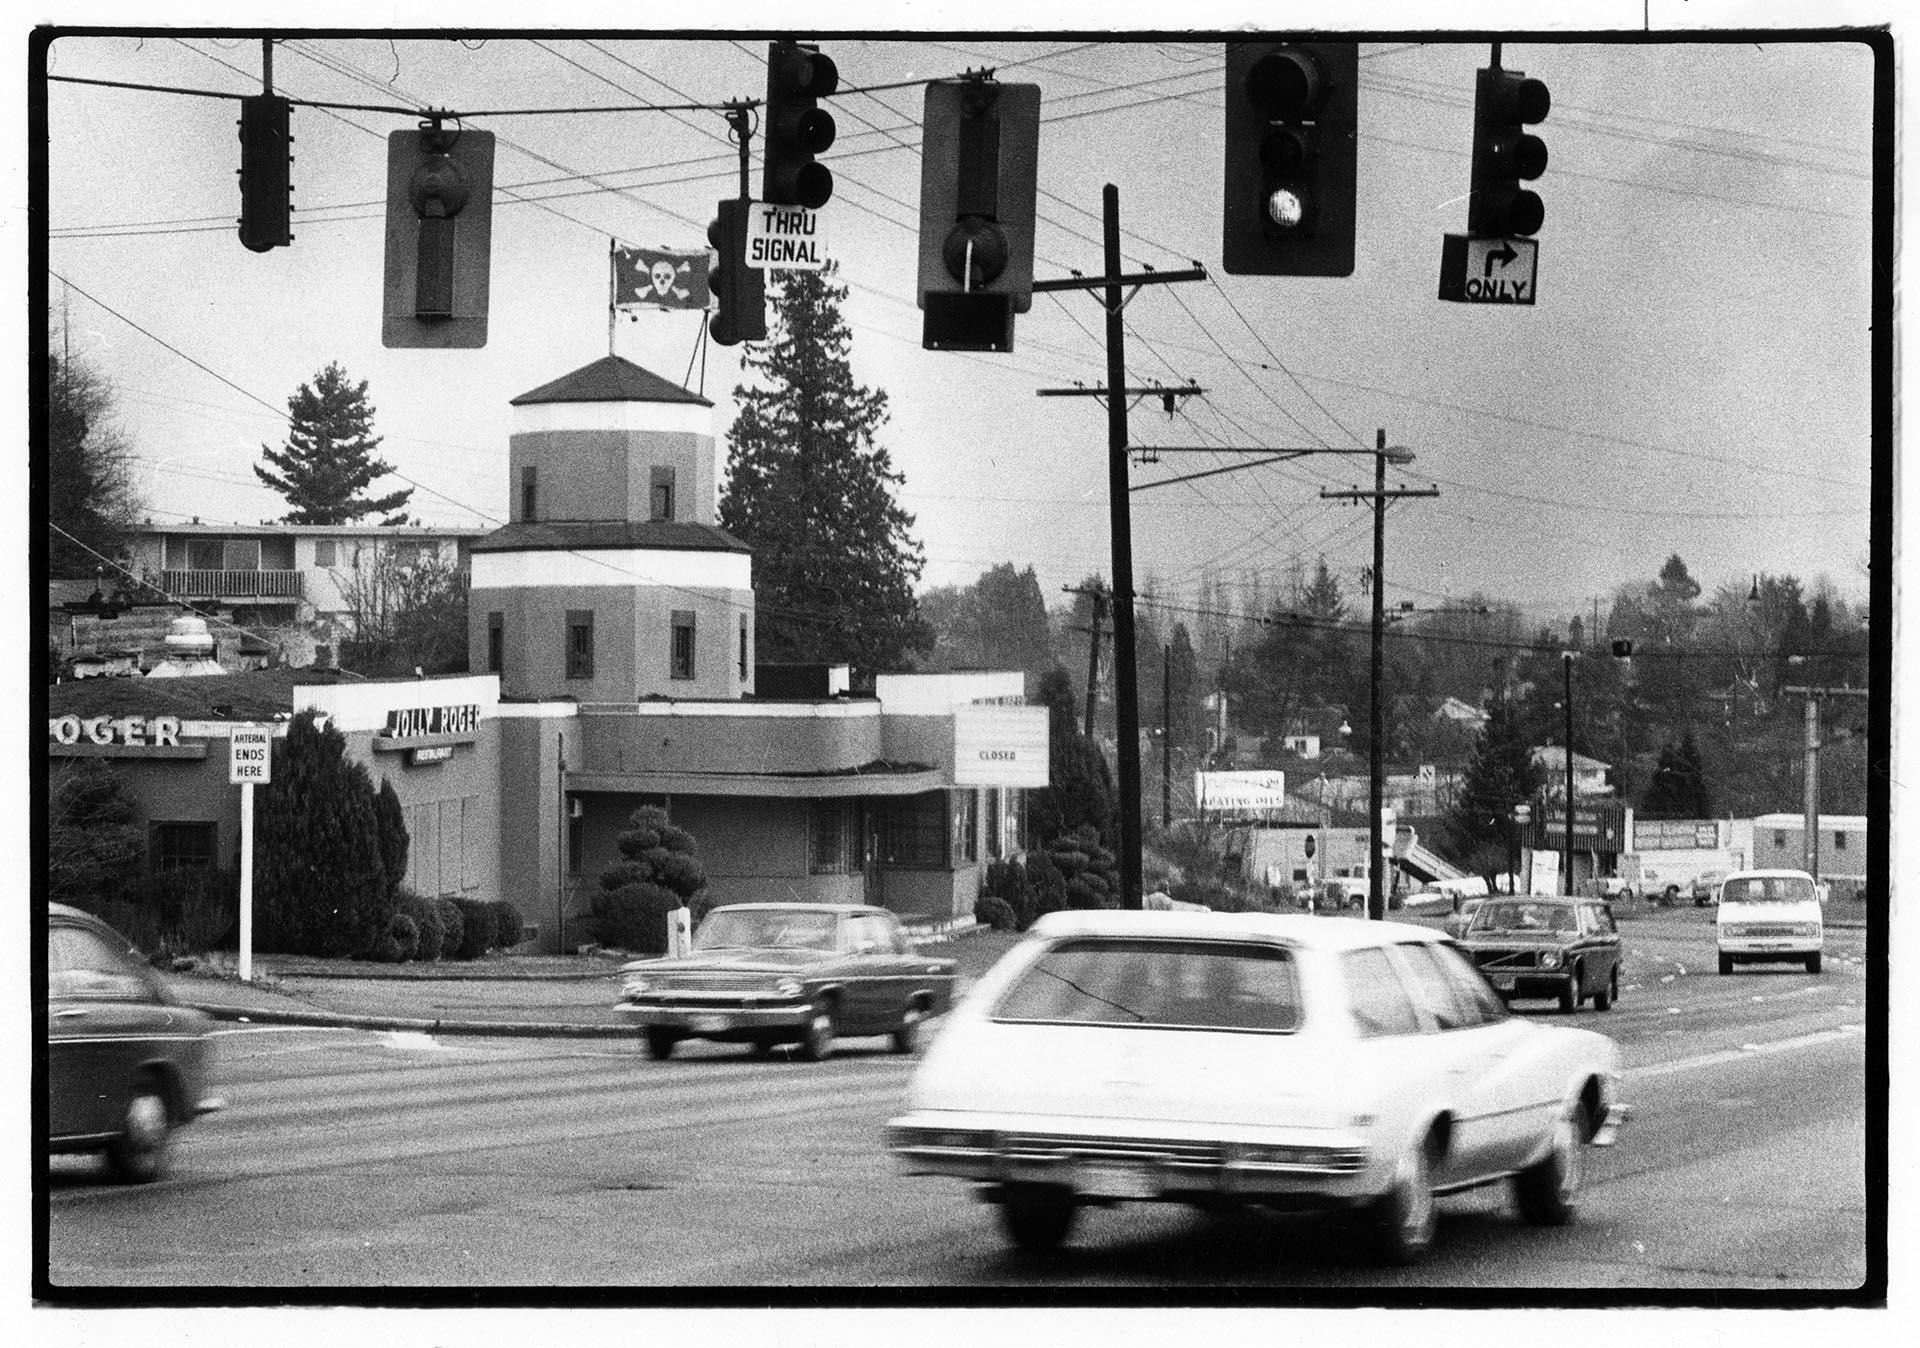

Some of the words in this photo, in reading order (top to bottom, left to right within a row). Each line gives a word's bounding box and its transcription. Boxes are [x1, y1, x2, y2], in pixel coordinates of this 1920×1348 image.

[763, 210, 816, 235] THRU
[752, 237, 821, 263] SIGNAL
[1466, 278, 1527, 301] ONLY
[392, 708, 434, 738] JOLLY
[441, 704, 481, 733] ROGER
[234, 734, 267, 743] ARTERIAL
[236, 749, 265, 760] ENDS
[979, 750, 1016, 761] CLOSED
[237, 766, 262, 776] HERE
